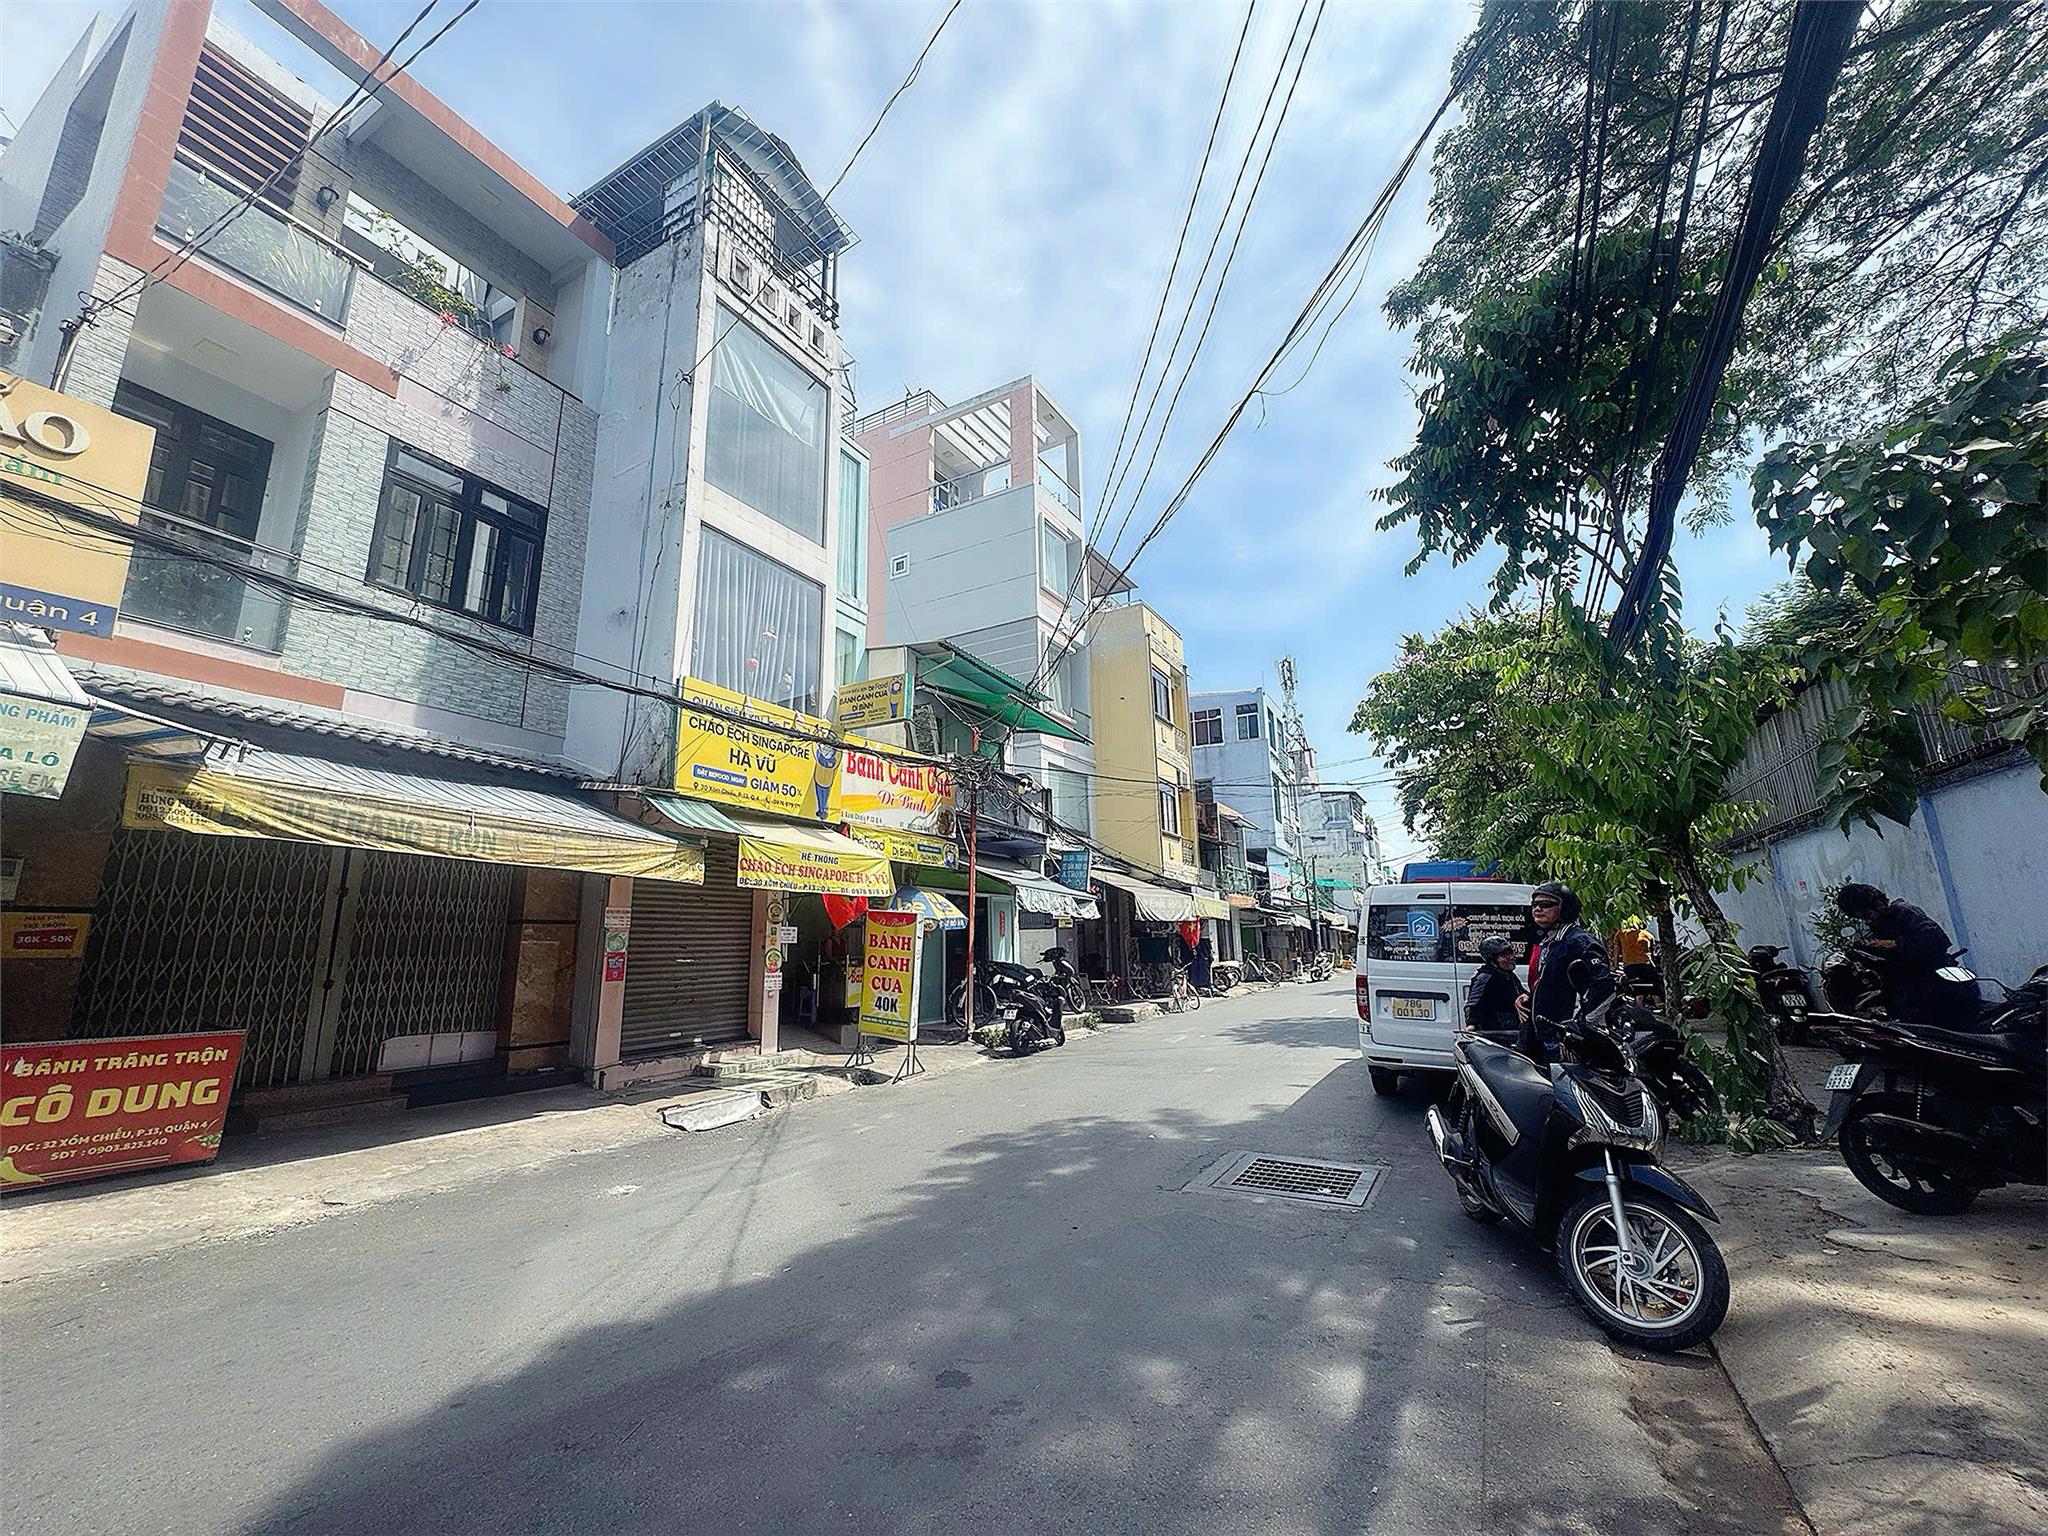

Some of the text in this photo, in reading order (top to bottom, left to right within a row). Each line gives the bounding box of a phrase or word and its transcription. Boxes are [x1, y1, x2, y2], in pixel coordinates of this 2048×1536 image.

[0, 592, 99, 627] uận 4
[751, 734, 810, 760] SINGAPORE
[25, 751, 59, 767] LÔ
[729, 748, 777, 774] HẠ VŨ
[28, 773, 57, 788] EM
[888, 758, 924, 791] Canh
[750, 775, 779, 795] GIẢM
[798, 865, 855, 883] SINGAPORE
[1415, 924, 1431, 934] 247
[868, 931, 913, 951] BÁNH
[867, 953, 911, 973] CANH
[870, 975, 903, 994] CUA
[874, 995, 898, 1014] 40K
[1396, 1008, 1430, 1018] 001.30
[1404, 1000, 1422, 1009] 78G
[16, 1047, 229, 1077] BÁNH TRÁNG TRỘN
[0, 1078, 221, 1126] CÔ DUNG
[42, 1139, 57, 1151] 32
[58, 1135, 89, 1147] XÓM
[164, 1121, 201, 1135] QUẬN
